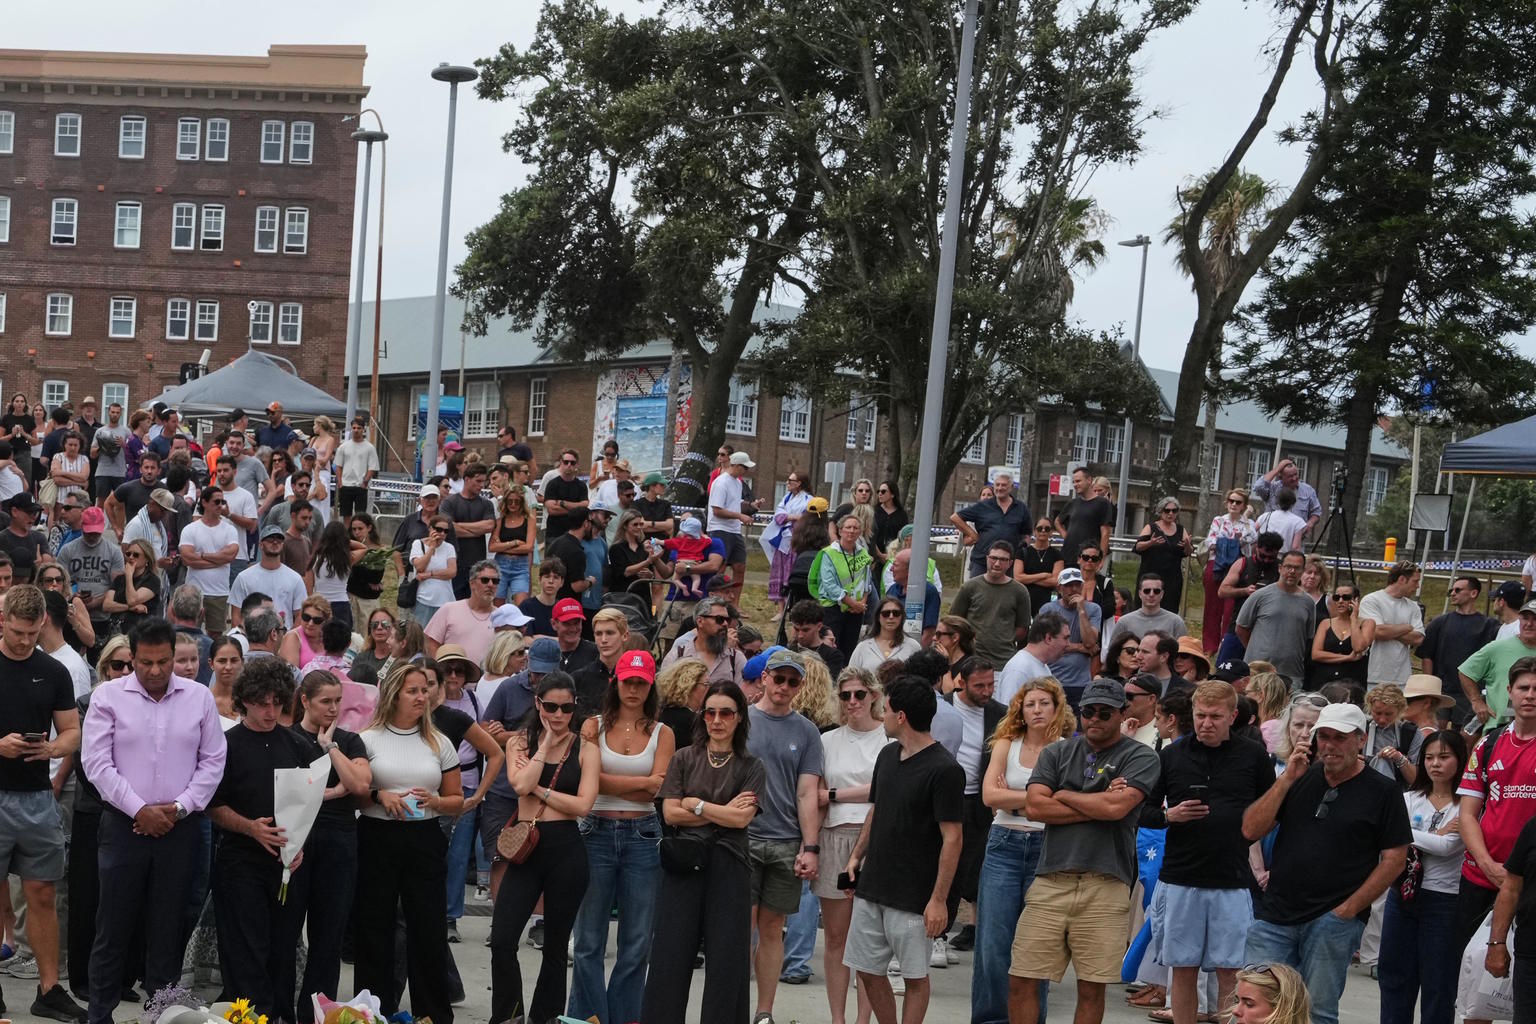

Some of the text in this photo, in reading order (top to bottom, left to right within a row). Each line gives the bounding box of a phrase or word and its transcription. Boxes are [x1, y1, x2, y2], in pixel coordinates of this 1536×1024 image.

[69, 556, 111, 573] DEUS
[1503, 784, 1536, 792] standar
[1503, 791, 1536, 799] chartere
